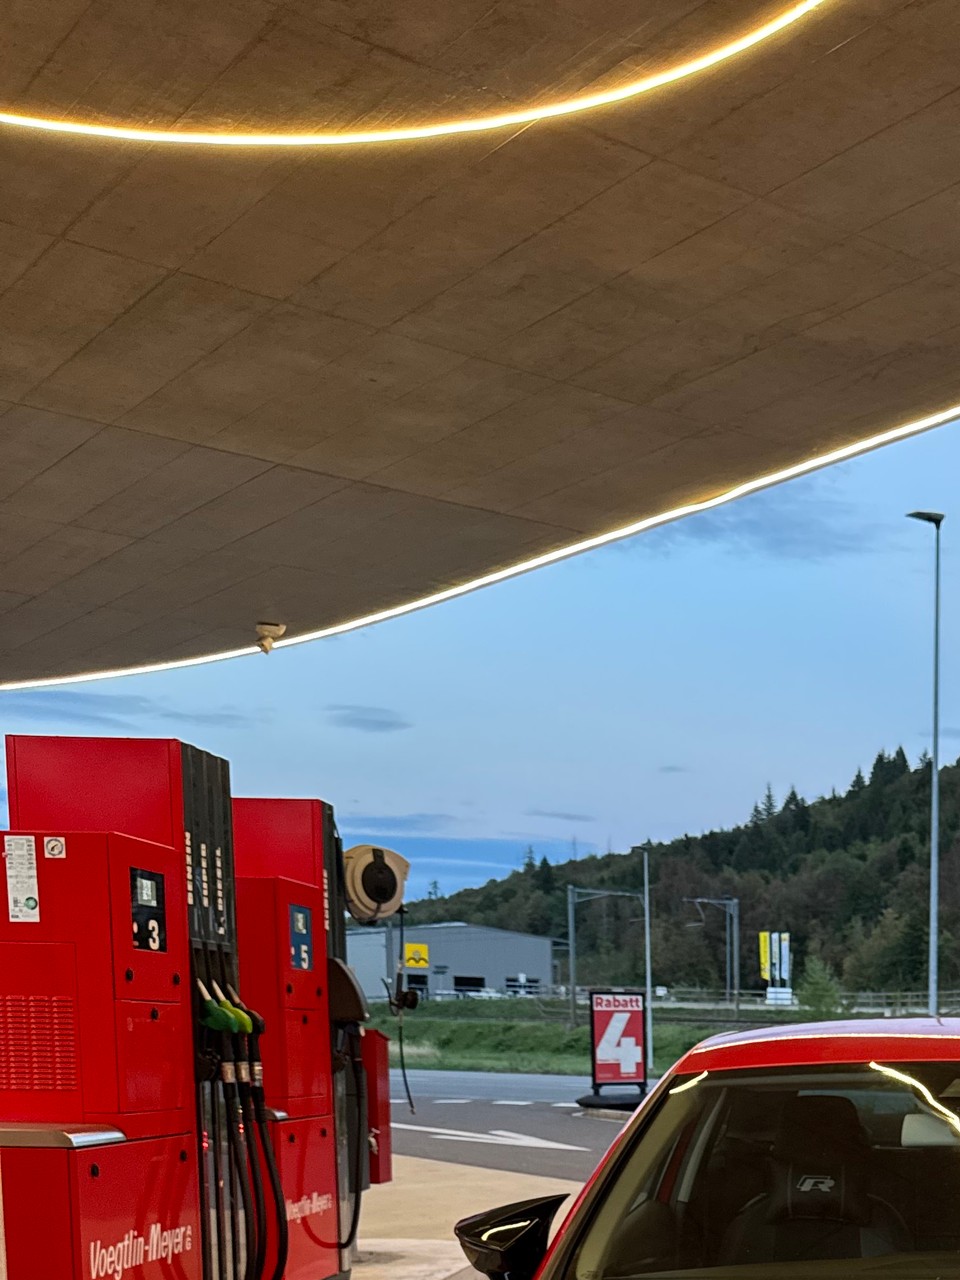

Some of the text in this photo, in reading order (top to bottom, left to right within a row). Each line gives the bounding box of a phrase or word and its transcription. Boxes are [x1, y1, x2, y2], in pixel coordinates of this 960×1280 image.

[148, 919, 160, 951] 3
[300, 944, 309, 970] 5
[595, 996, 640, 1008] Rabatt
[595, 1012, 642, 1073] 4
[90, 1223, 186, 1280] Voegtlin-Meyer
